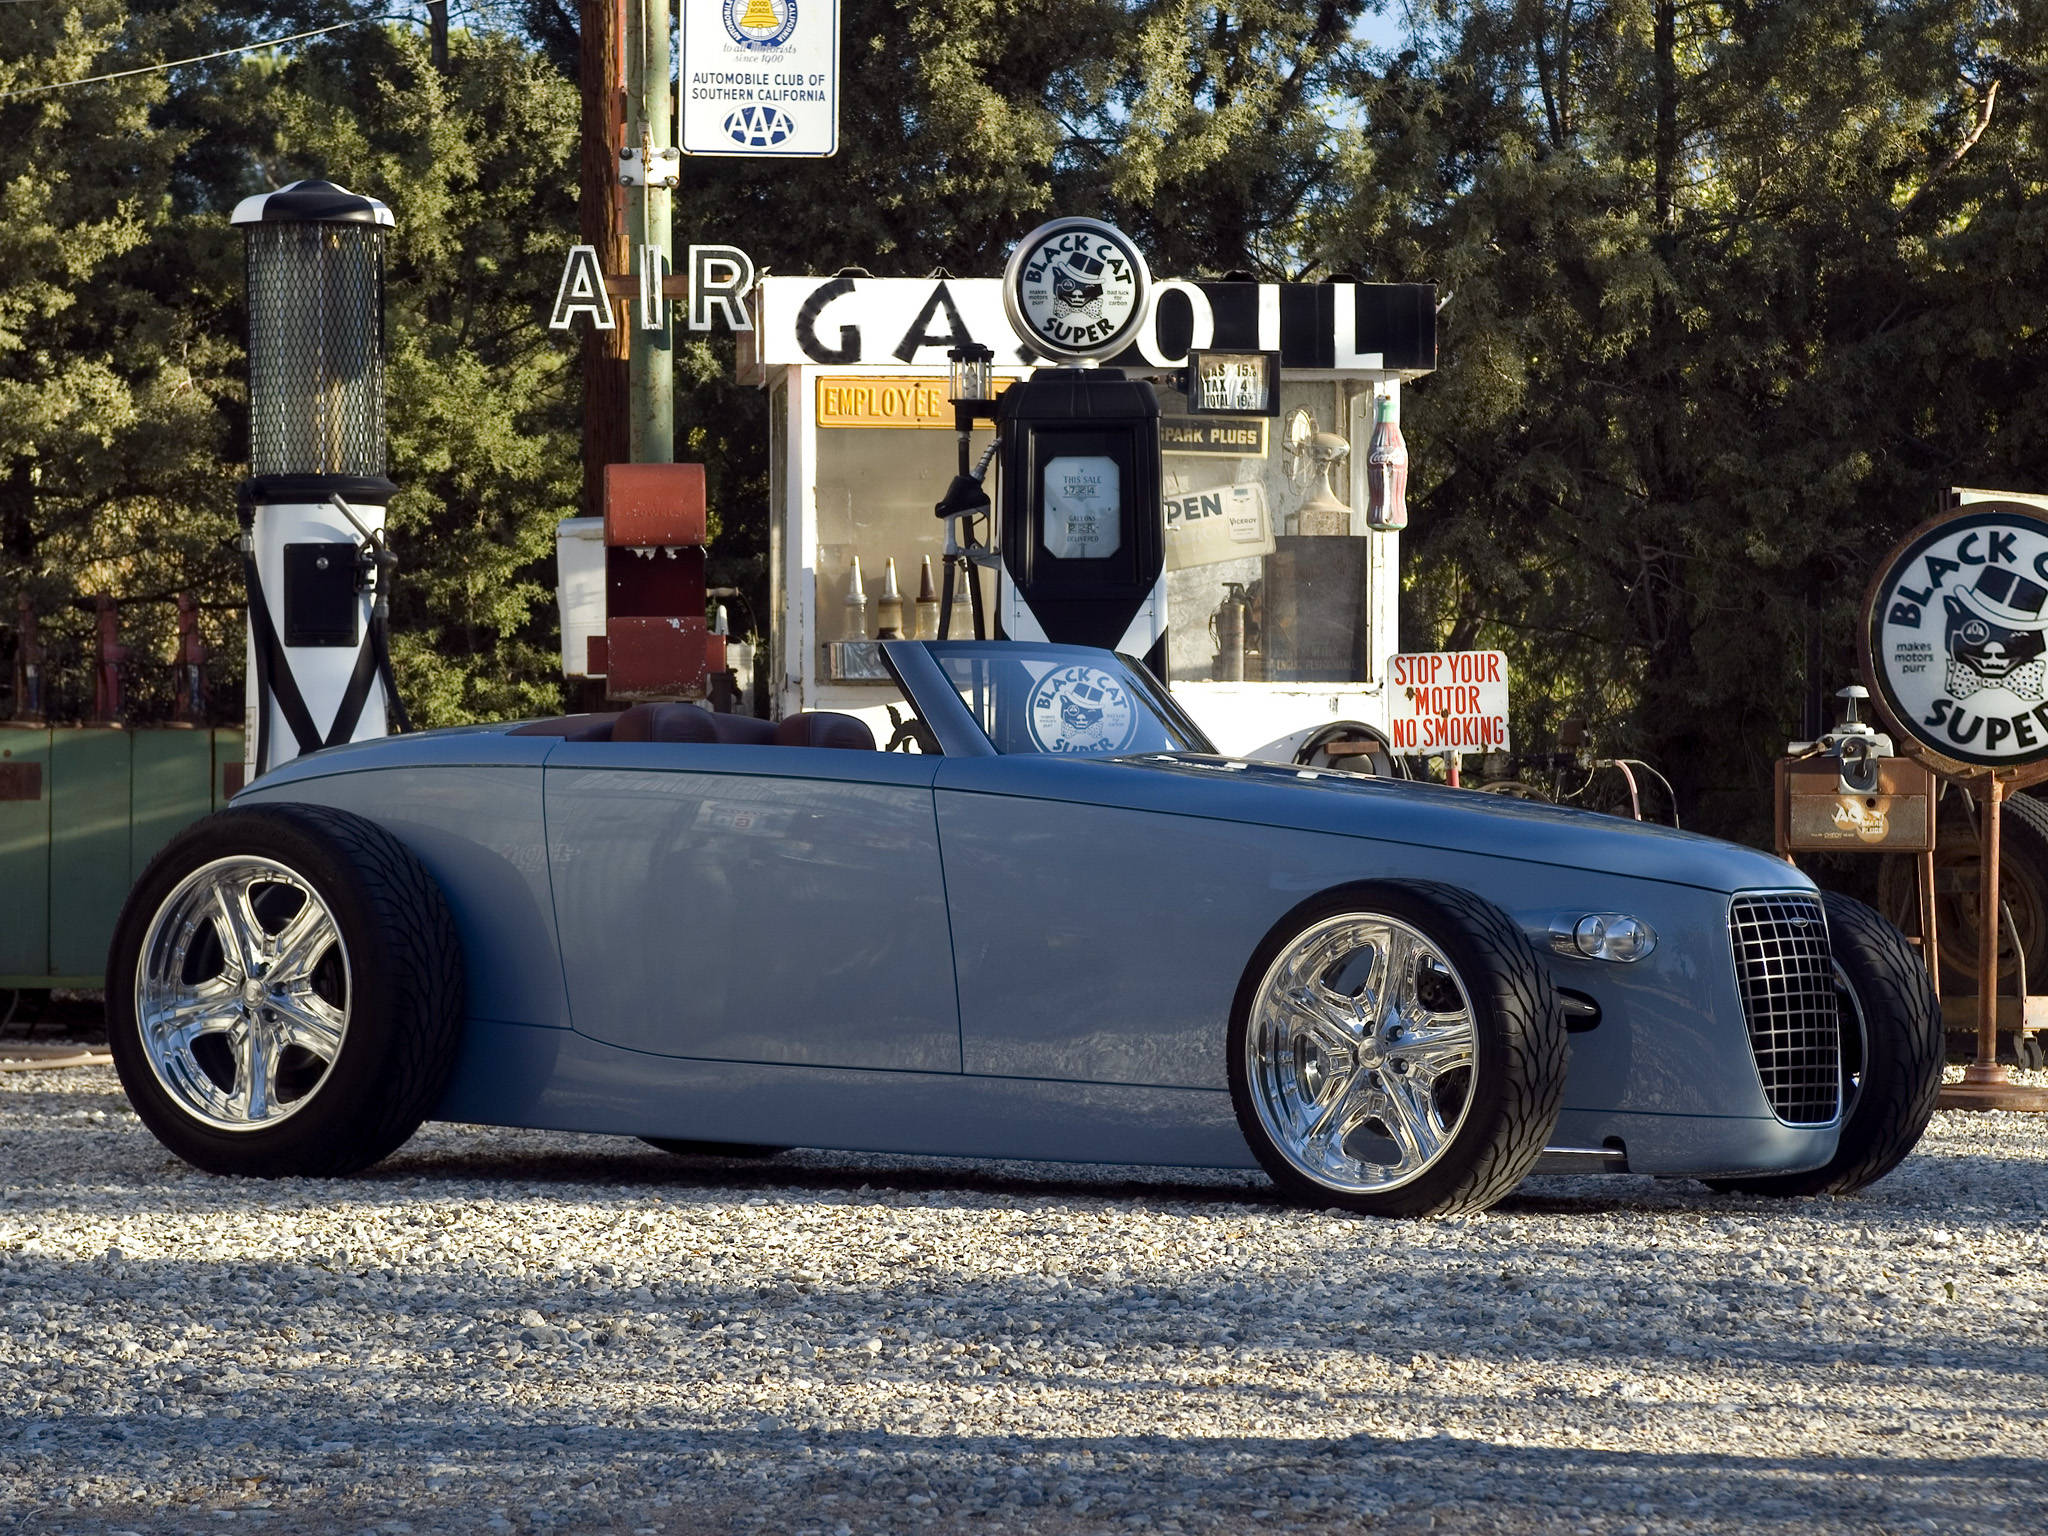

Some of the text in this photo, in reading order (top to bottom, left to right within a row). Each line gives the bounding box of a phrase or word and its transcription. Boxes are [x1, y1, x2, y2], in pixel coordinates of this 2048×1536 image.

[777, 2, 797, 42] CALIFORNIA
[761, 54, 785, 64] 1900
[691, 87, 826, 102] SOUTHERN CALIFORNIA
[693, 73, 825, 86] AUTOMOBILE CLUB OF
[726, 105, 794, 148] AAA
[1025, 235, 1132, 285] BLACK CAT
[549, 244, 755, 331] AIR
[1043, 318, 1115, 344] SUPER
[1137, 281, 1383, 370] OIL
[1205, 380, 1248, 392] TAX 4
[1205, 394, 1230, 408] TOTAL
[825, 387, 941, 417] EMPLOYEE
[1210, 429, 1257, 445] PLUGS
[1164, 493, 1223, 524] PEN
[1888, 531, 2017, 629] BLACK
[1894, 653, 1934, 663] motors
[1896, 641, 1932, 652] makes
[1394, 653, 1501, 686] STOP YOUR
[1902, 664, 1926, 674] purr
[1036, 668, 1128, 710] BLACK CAT
[1415, 686, 1482, 716] MOTOR
[1393, 716, 1504, 748] NO SMOKING
